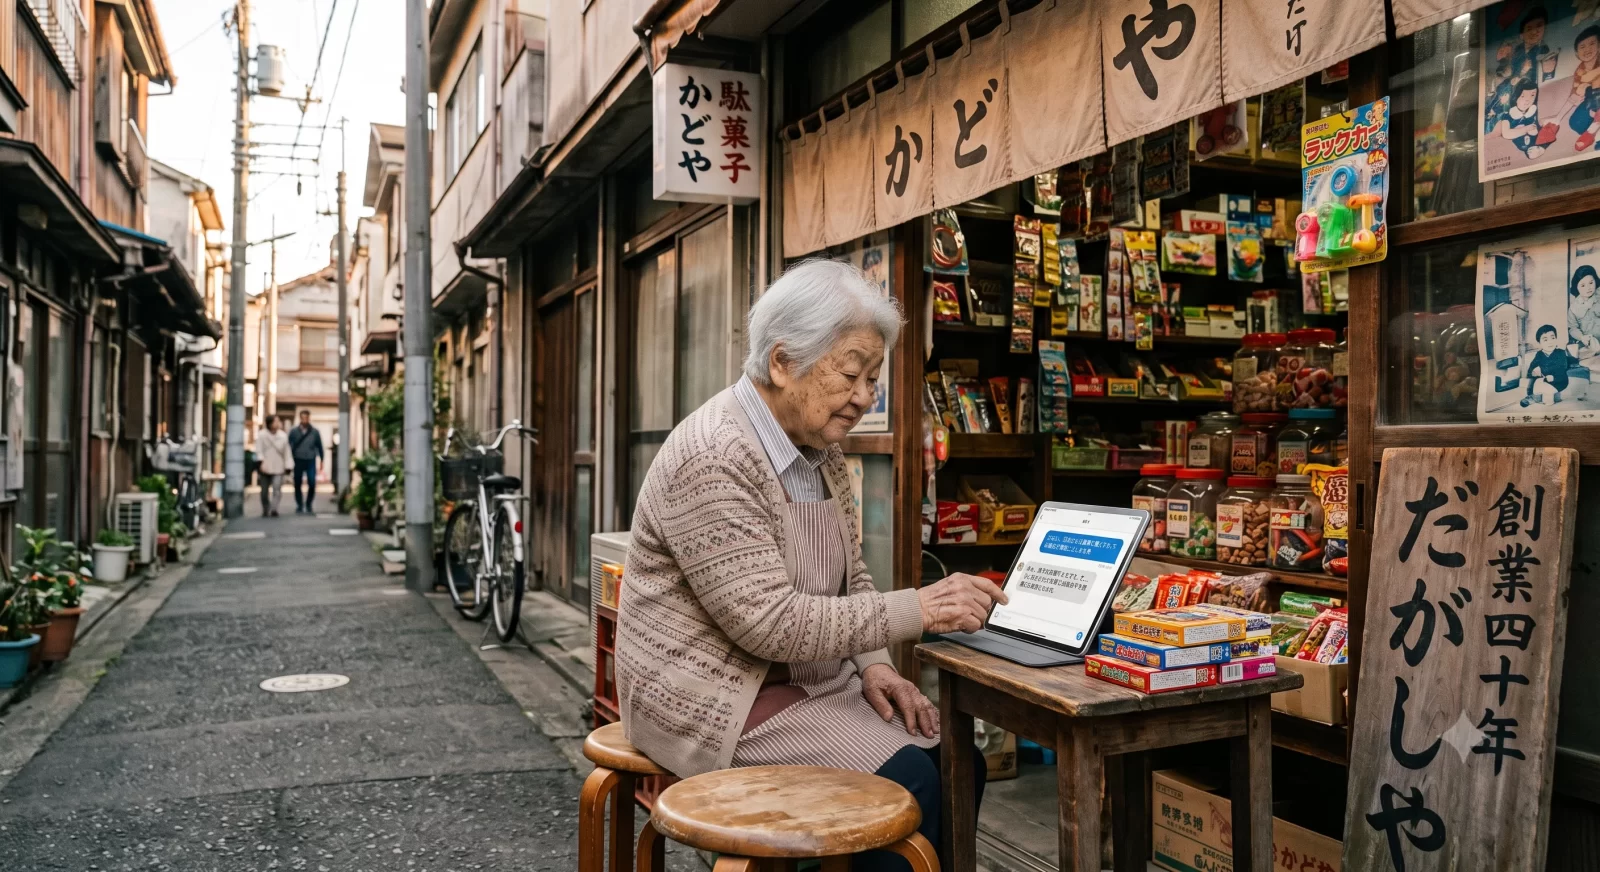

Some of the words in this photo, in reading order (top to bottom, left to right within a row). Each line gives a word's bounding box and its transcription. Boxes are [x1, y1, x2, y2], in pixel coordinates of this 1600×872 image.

[678, 76, 713, 184] かどや
[719, 81, 752, 184] 駄菓子
[1365, 476, 1479, 872] だがしや
[1472, 482, 1546, 777] 創業四十年
